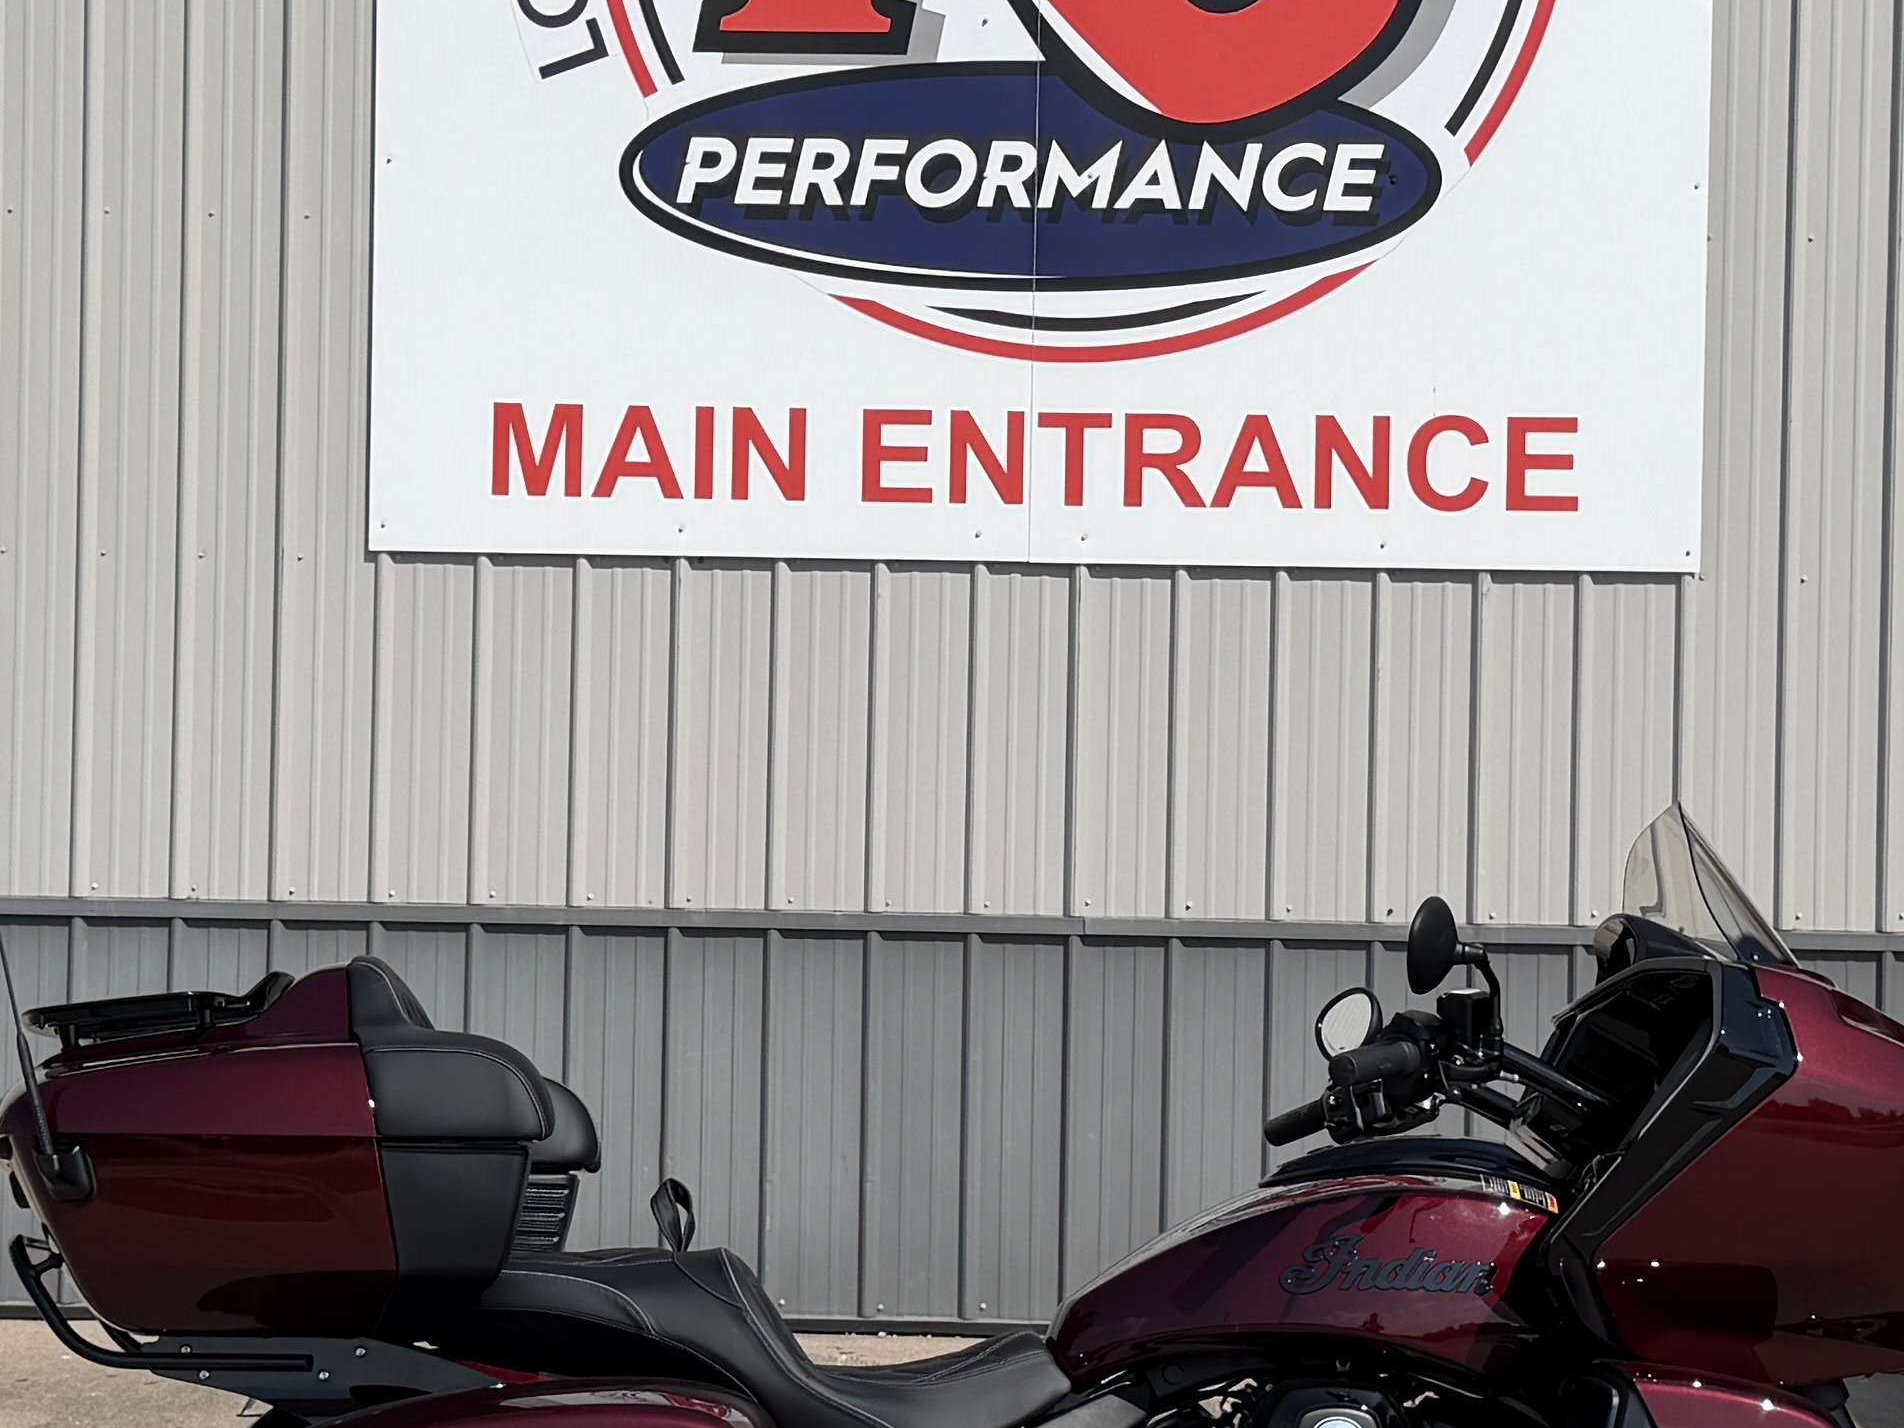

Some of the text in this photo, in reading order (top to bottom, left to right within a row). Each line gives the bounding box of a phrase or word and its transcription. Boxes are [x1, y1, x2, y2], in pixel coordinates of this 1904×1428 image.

[674, 136, 1386, 216] PERFORMANCE
[490, 401, 1581, 514] MAIN ENTRANCE
[1279, 1235, 1496, 1296] Indian
